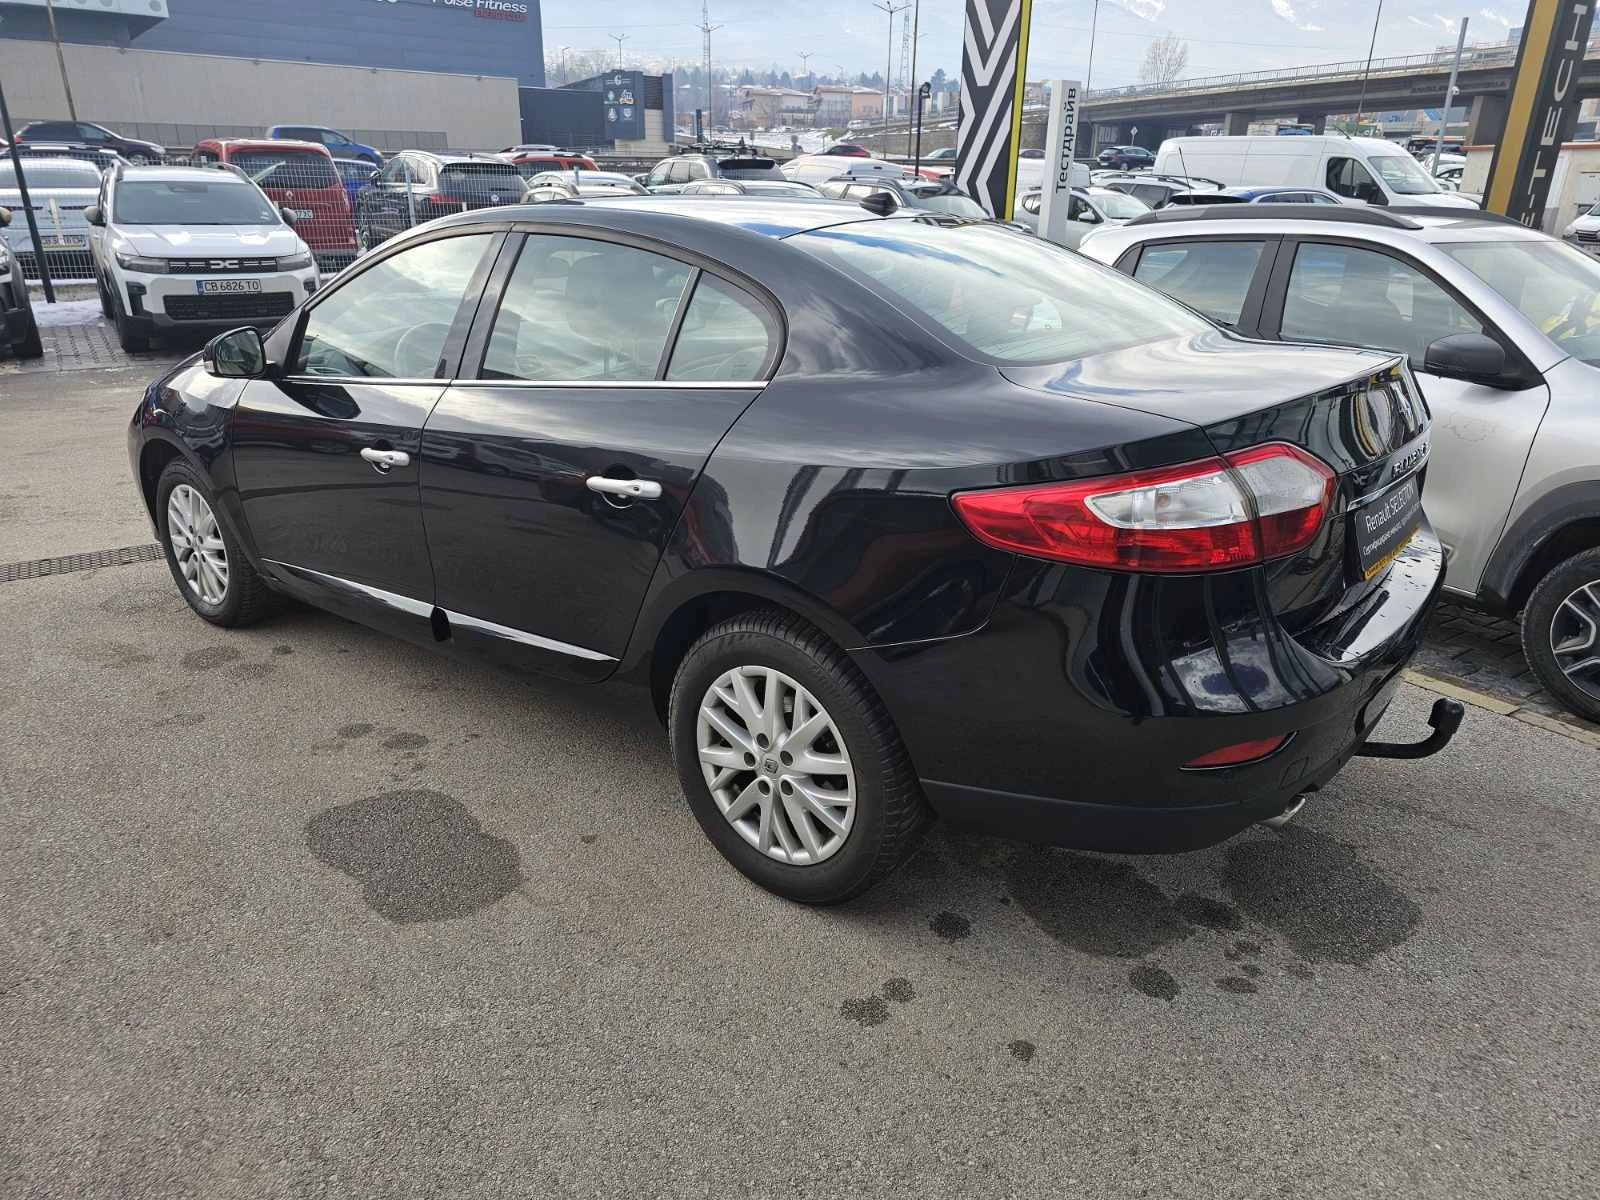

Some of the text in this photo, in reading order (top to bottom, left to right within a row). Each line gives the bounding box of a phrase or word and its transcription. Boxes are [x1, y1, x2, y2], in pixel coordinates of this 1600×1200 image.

[476, 0, 528, 13] Fitness
[1056, 87, 1076, 194] Тестдрайв
[220, 281, 245, 291] 6826
[1365, 503, 1391, 534] Renault
